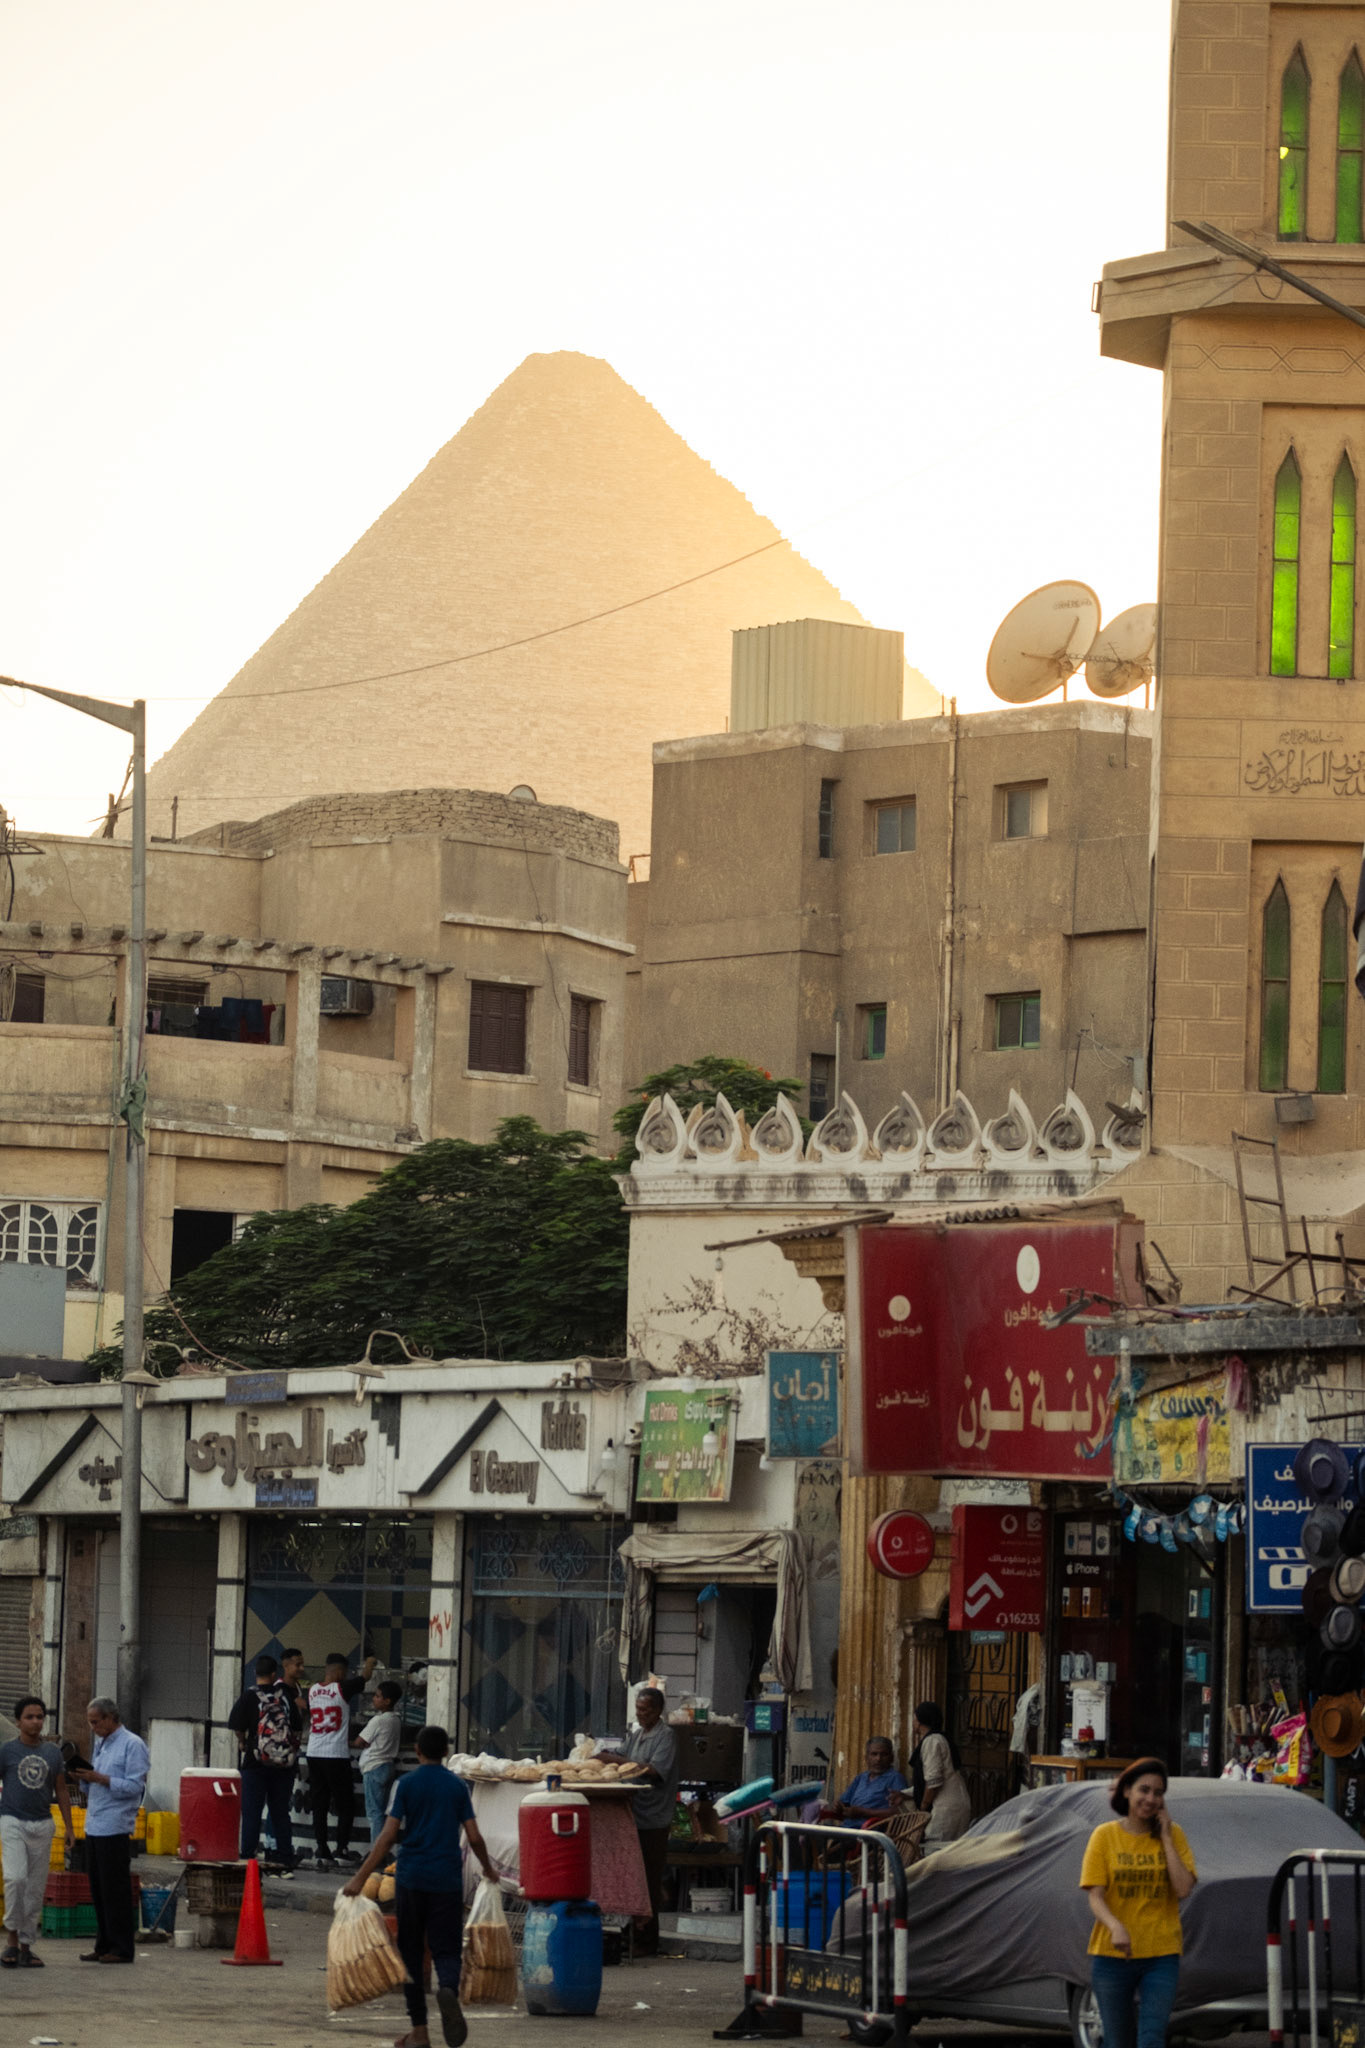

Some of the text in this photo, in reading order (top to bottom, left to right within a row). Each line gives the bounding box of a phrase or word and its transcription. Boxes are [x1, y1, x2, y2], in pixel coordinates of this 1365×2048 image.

[878, 1323, 924, 1338] فودافون
[773, 1357, 832, 1402] أمان
[876, 1392, 902, 1409] فون
[957, 1366, 1025, 1451] فون
[660, 1401, 678, 1421] Drinks
[470, 1450, 485, 1494] El
[1074, 1563, 1100, 1575] iPhone
[1009, 1613, 1041, 1626] 16233
[310, 1706, 342, 1734] 23
[1117, 1853, 1134, 1865] YOU
[1136, 1854, 1154, 1865] CAN
